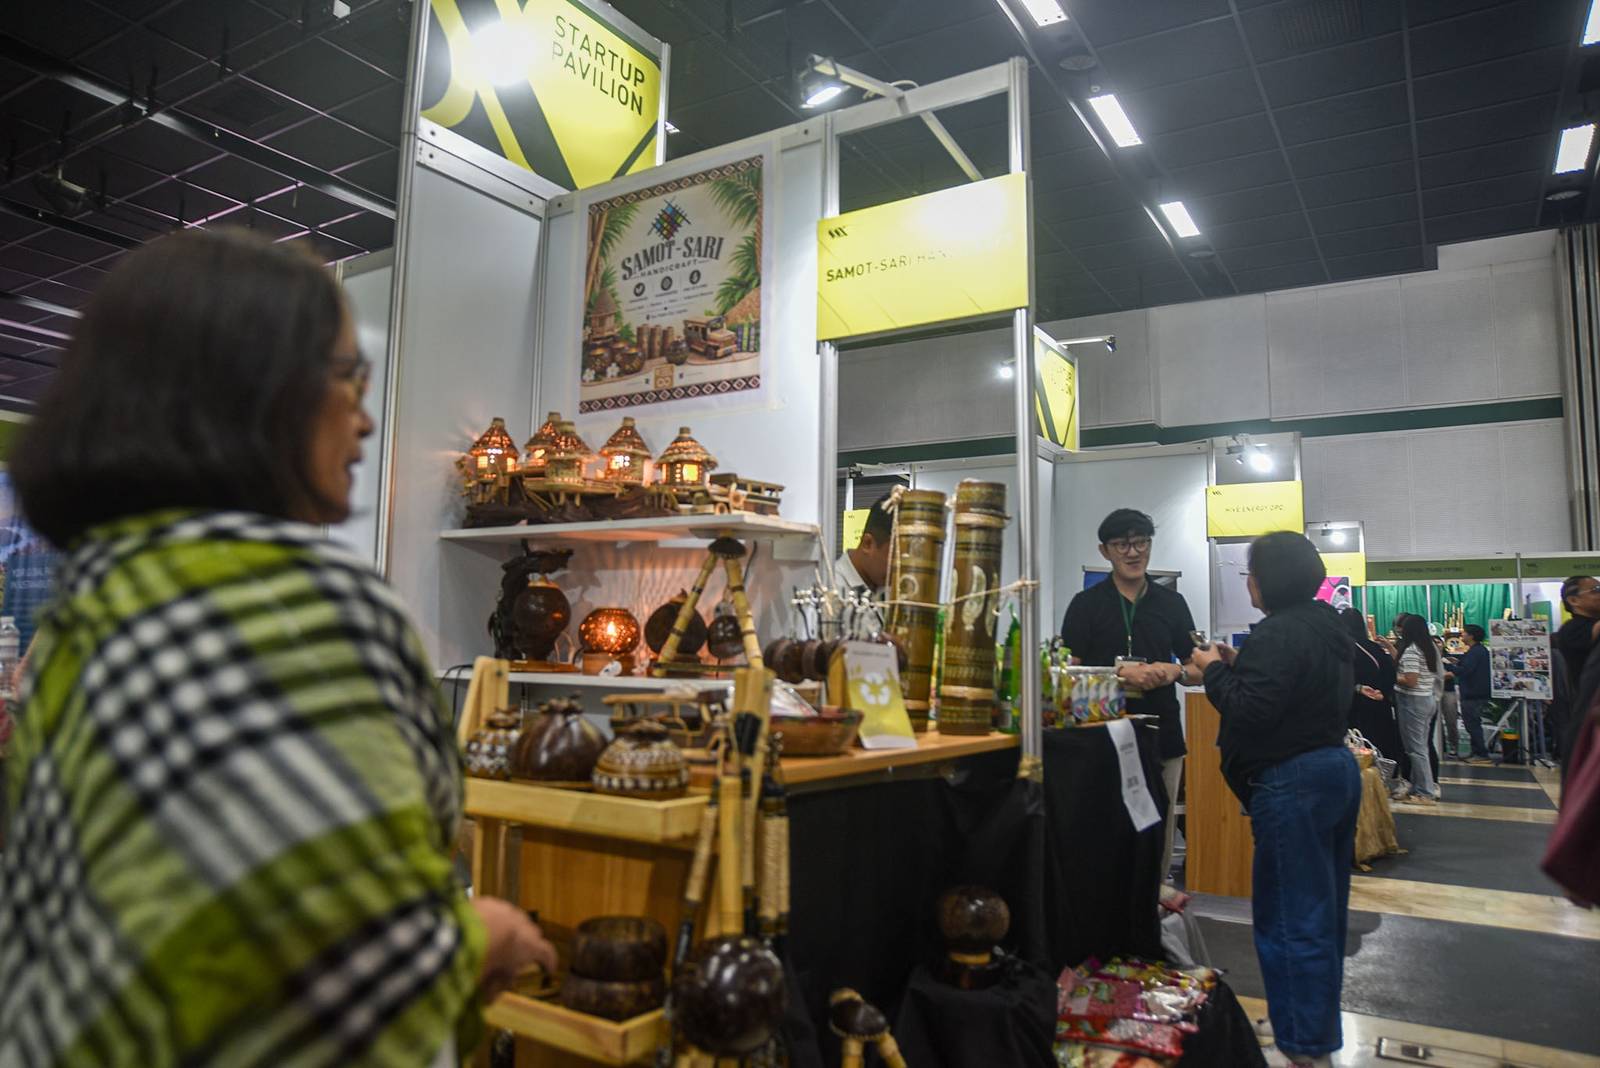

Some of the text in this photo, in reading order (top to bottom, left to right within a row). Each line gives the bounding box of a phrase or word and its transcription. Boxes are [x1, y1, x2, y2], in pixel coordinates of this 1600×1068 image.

[552, 41, 643, 116] PAVILION
[555, 15, 645, 87] STARTUP
[621, 235, 724, 281] SAMOT-SARI
[640, 259, 698, 277] HANDICRAFT
